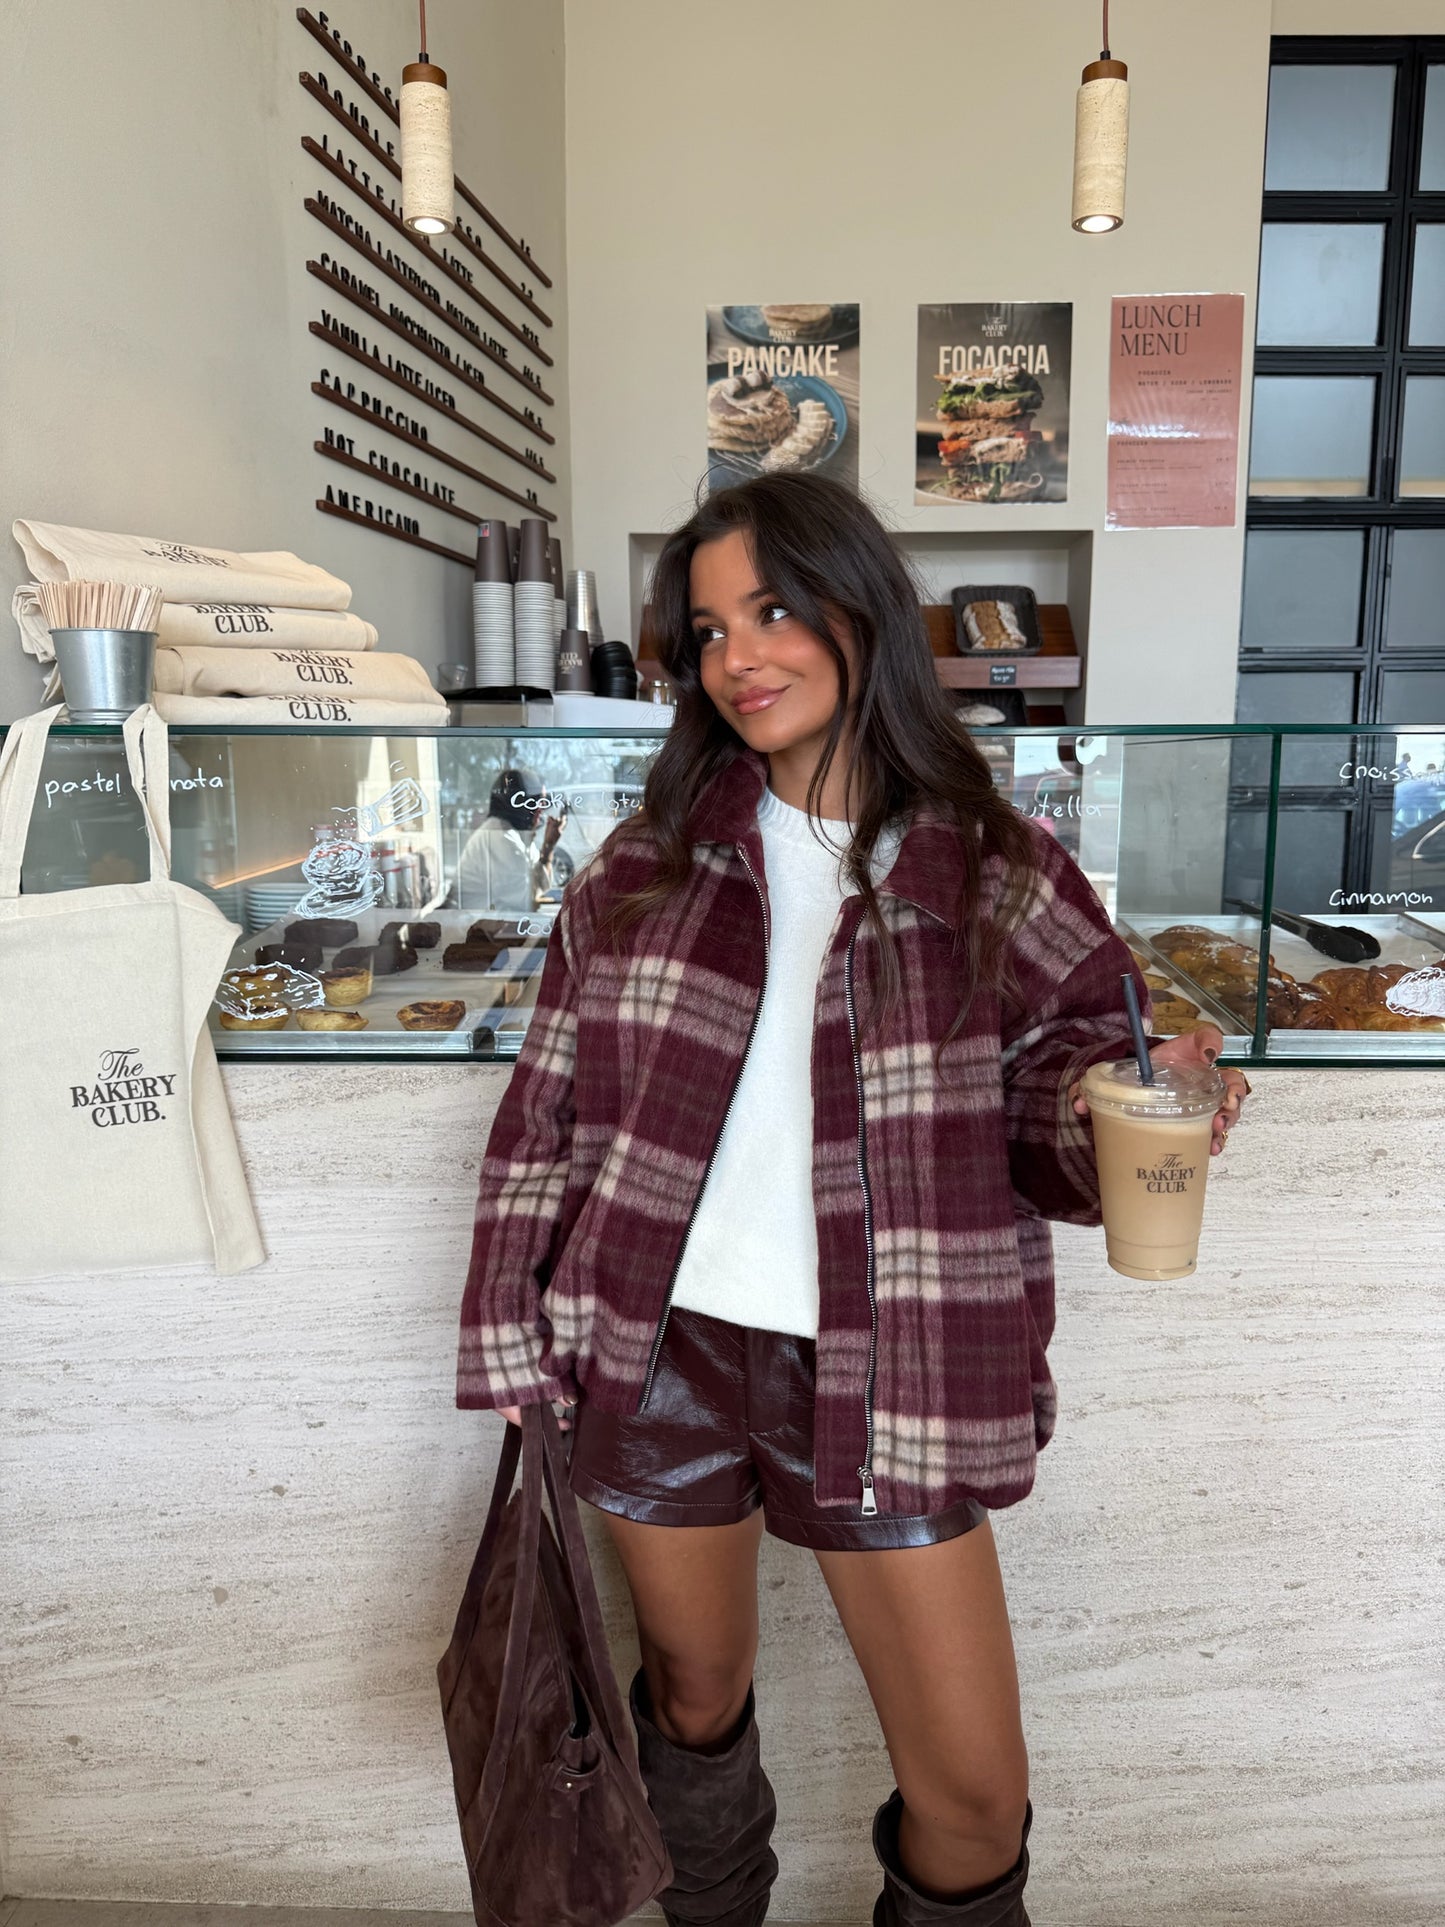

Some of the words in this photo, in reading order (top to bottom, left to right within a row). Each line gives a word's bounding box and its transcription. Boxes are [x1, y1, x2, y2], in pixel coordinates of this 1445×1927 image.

[317, 190, 373, 251] MATCHA
[320, 252, 379, 308] CARAMEL
[1120, 304, 1202, 329] LUNCH
[321, 309, 381, 362] VANILLA
[1119, 332, 1189, 357] MENU
[727, 344, 840, 378] PANCAKE
[938, 344, 1051, 375] FOCACCIA
[320, 368, 429, 443] CAPPUCCINO
[324, 426, 356, 457] HOT
[368, 450, 456, 505] CHOCOLATE
[325, 484, 420, 538] AMERICANO
[214, 615, 274, 634] CLUB.
[296, 664, 353, 685] CLUB.
[288, 701, 352, 721] CLUB.
[44, 771, 121, 808] pastel
[170, 767, 224, 791] nata
[1328, 888, 1433, 907] Cinnamon
[97, 1047, 144, 1081] The
[69, 1074, 177, 1108] BAKERY
[91, 1100, 167, 1128] CLUB.
[1136, 1166, 1196, 1181] BAKERY
[1154, 1153, 1184, 1168] The
[1146, 1181, 1187, 1193] CLUB.
